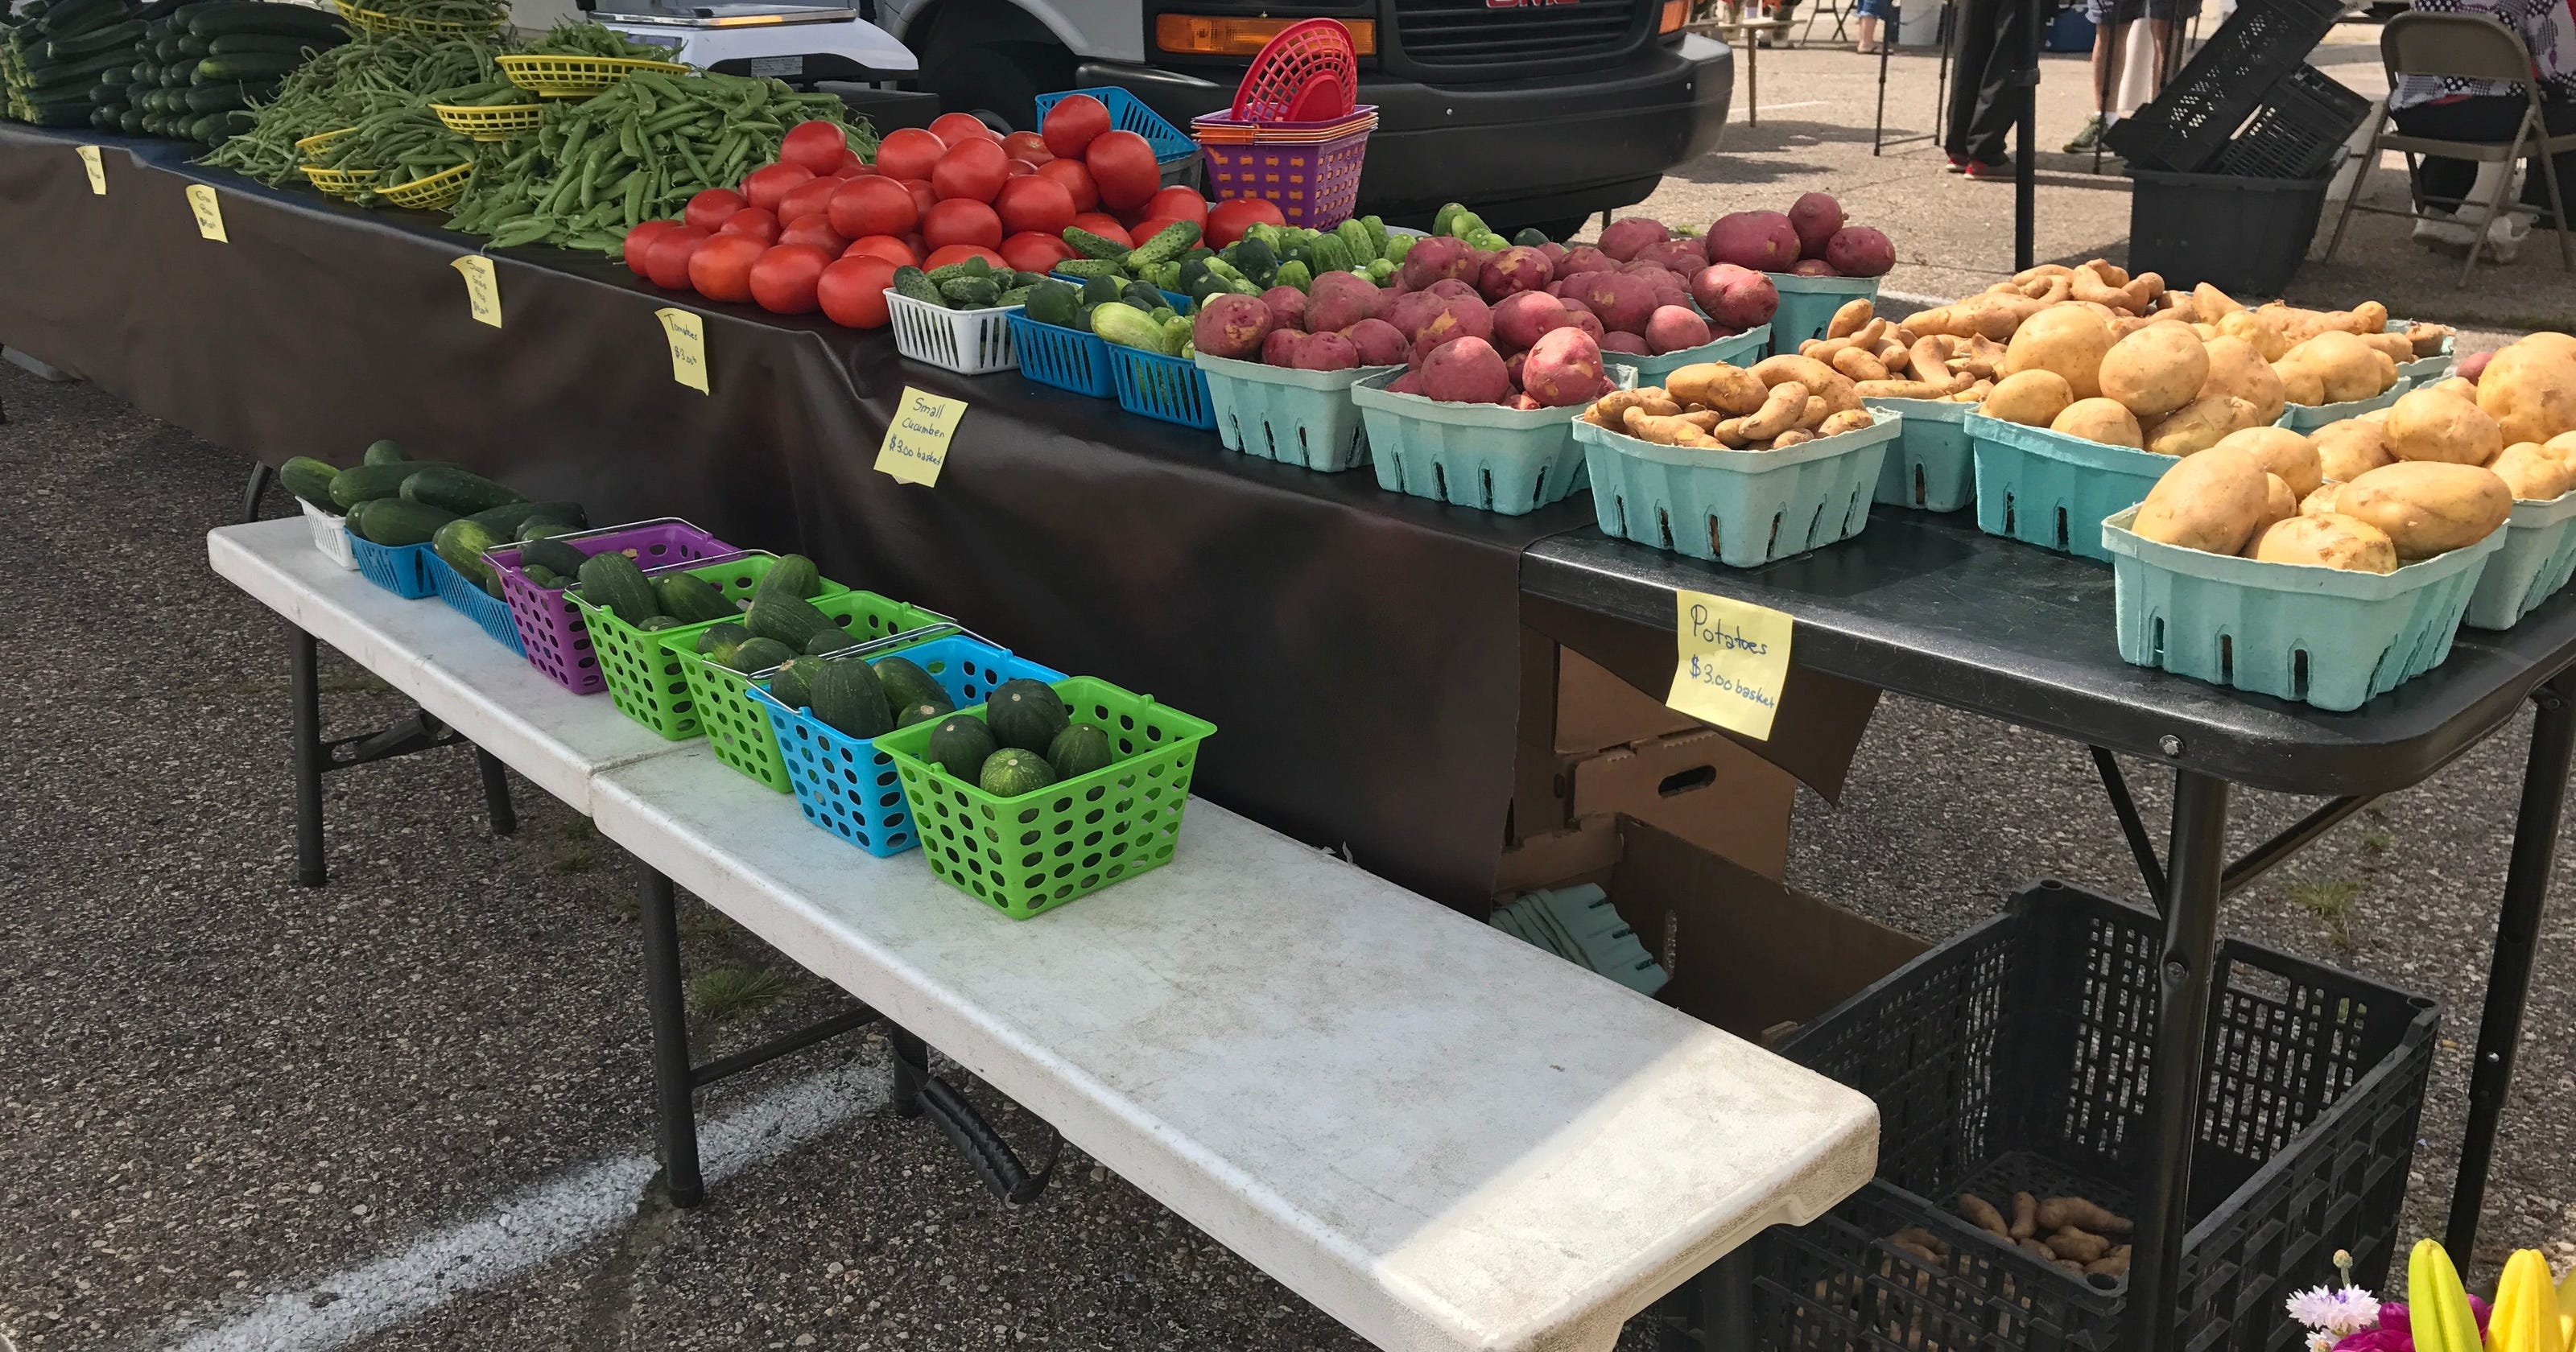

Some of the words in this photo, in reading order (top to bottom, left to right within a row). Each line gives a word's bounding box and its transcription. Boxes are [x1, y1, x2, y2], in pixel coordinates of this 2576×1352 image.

[913, 398, 945, 418] Small
[917, 447, 942, 465] basket
[1690, 604, 1768, 655] Potatoes
[1690, 653, 1732, 690] $3.00
[1735, 678, 1775, 709] basket
